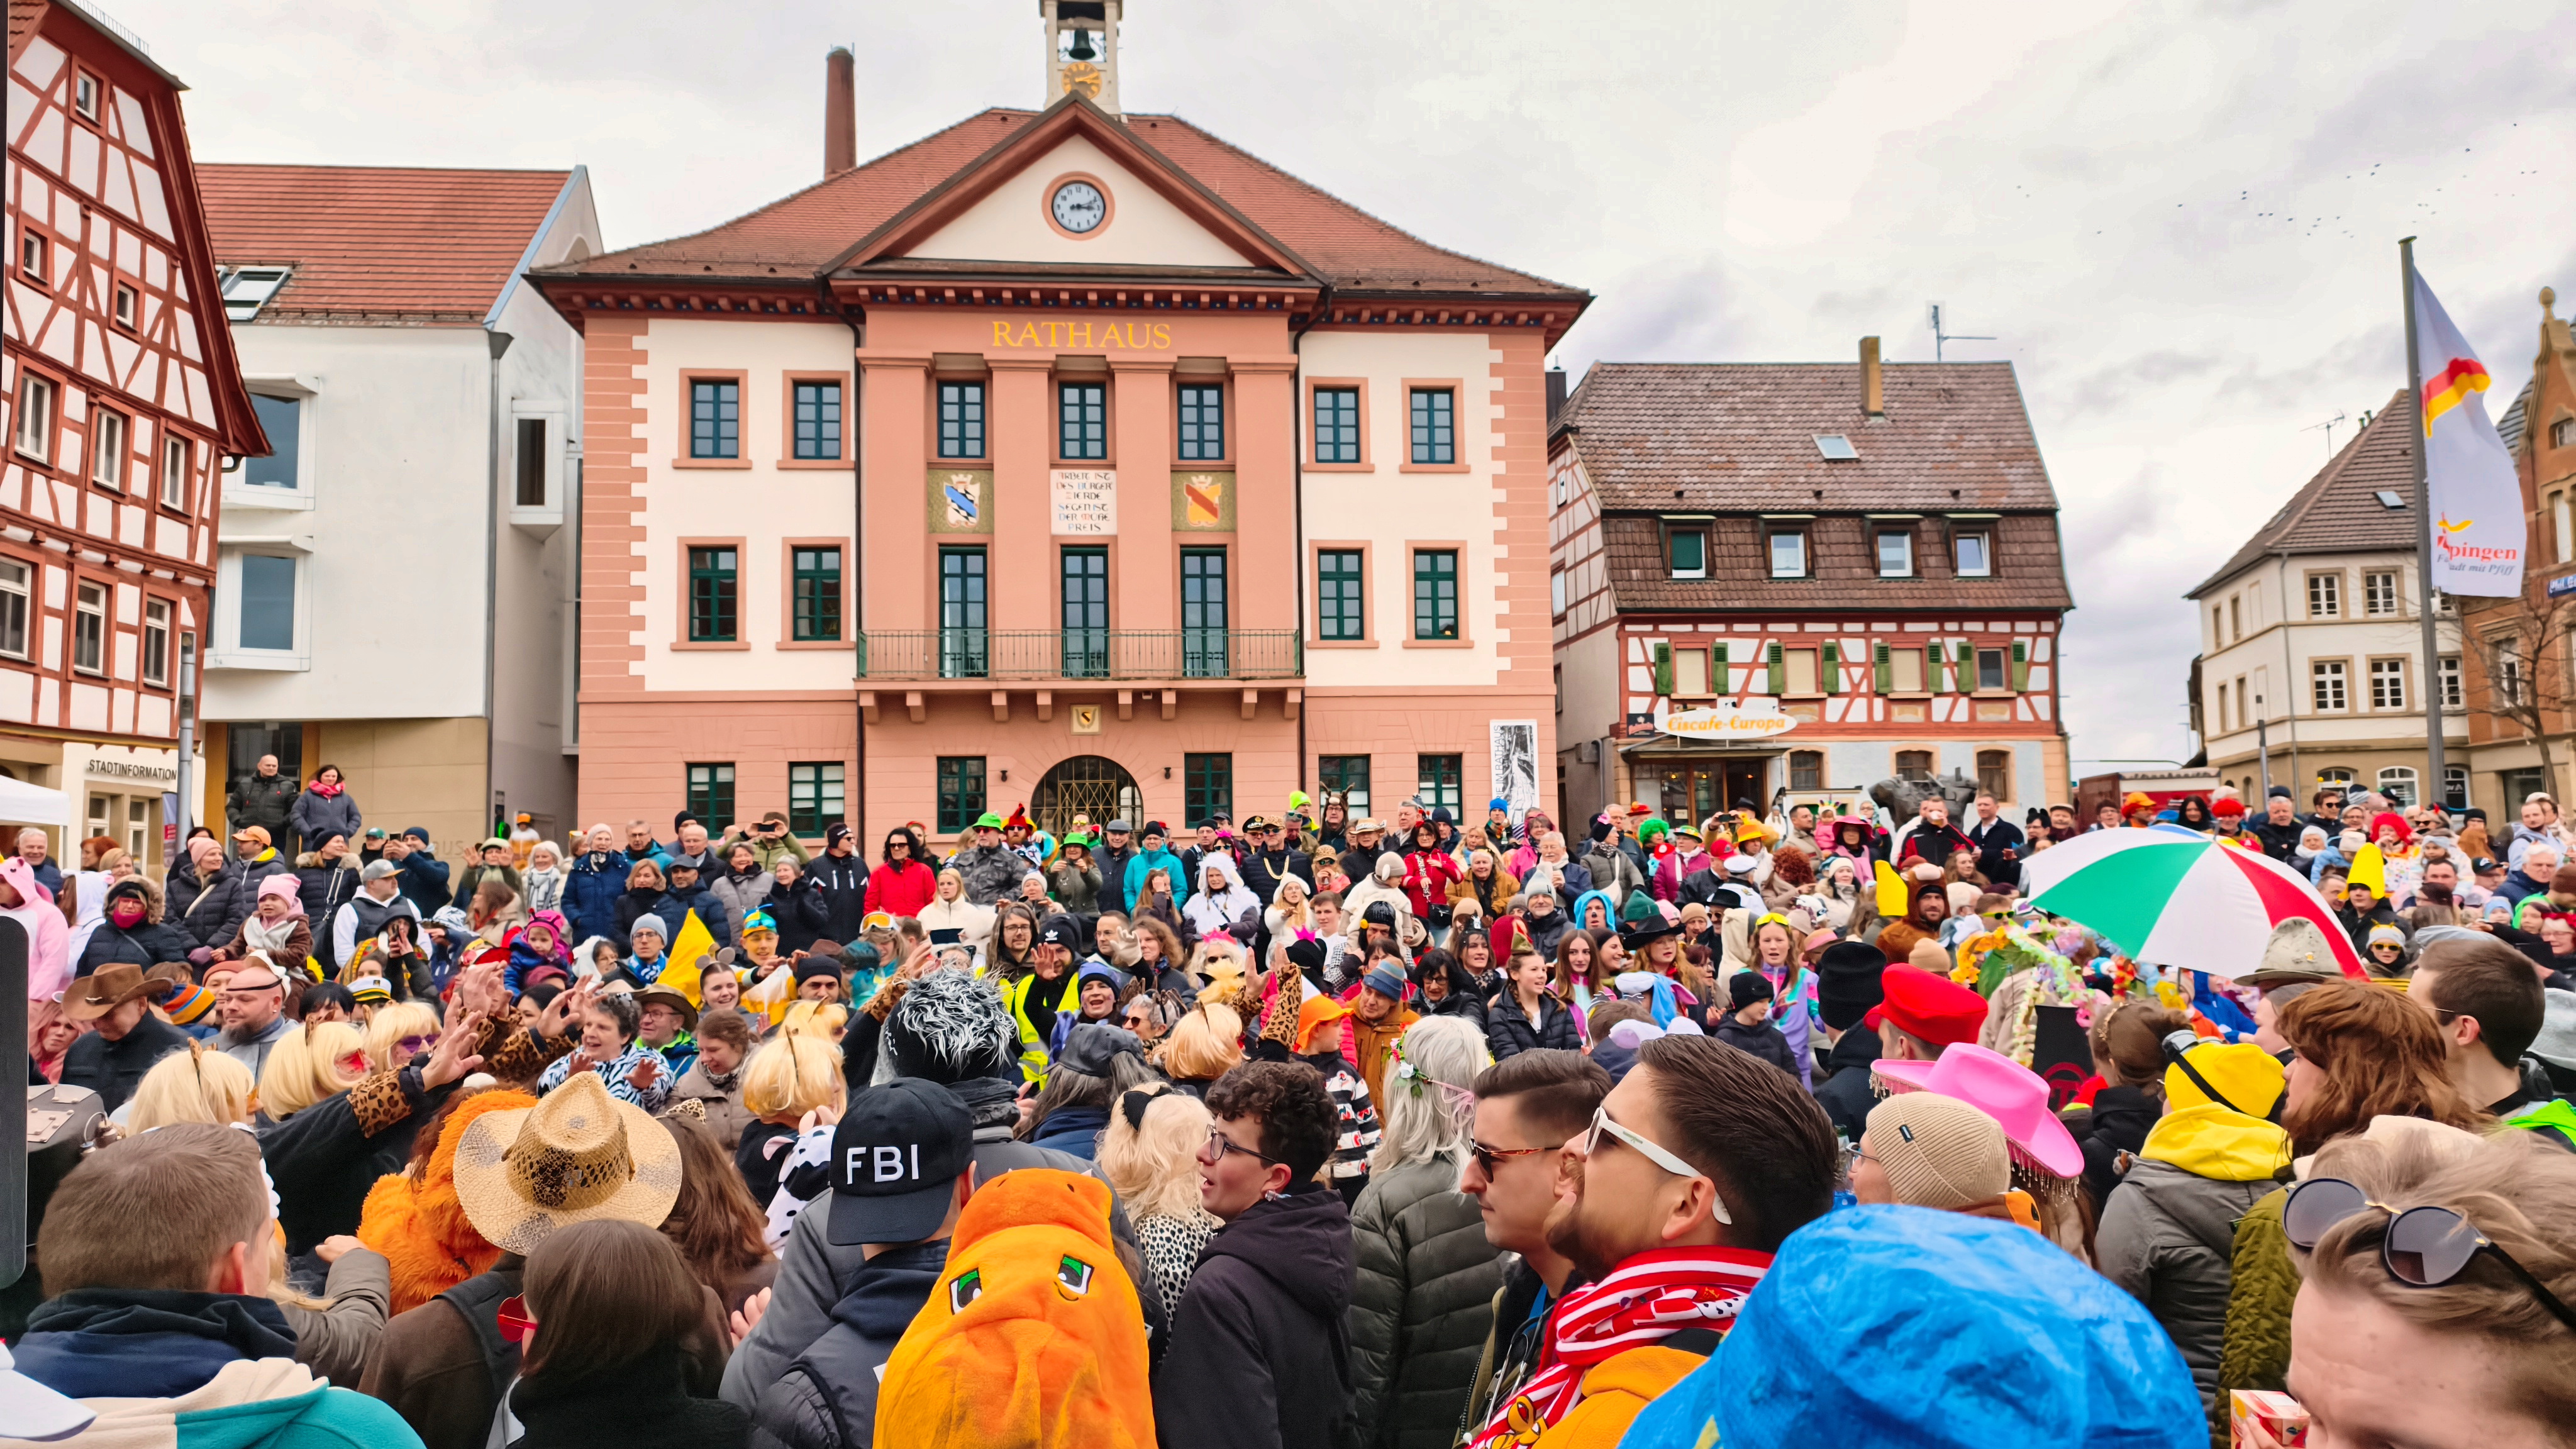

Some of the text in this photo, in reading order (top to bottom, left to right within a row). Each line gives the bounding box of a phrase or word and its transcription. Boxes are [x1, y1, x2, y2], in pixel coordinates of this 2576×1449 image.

[992, 321, 1171, 349] RATHAUS
[1095, 472, 1110, 480] IST
[1059, 513, 1078, 521] DER
[1068, 523, 1101, 532] PREIS
[1494, 725, 1504, 770] RATHAUS
[89, 759, 177, 780] STADTINFORMATION
[847, 1144, 919, 1185] FBI
